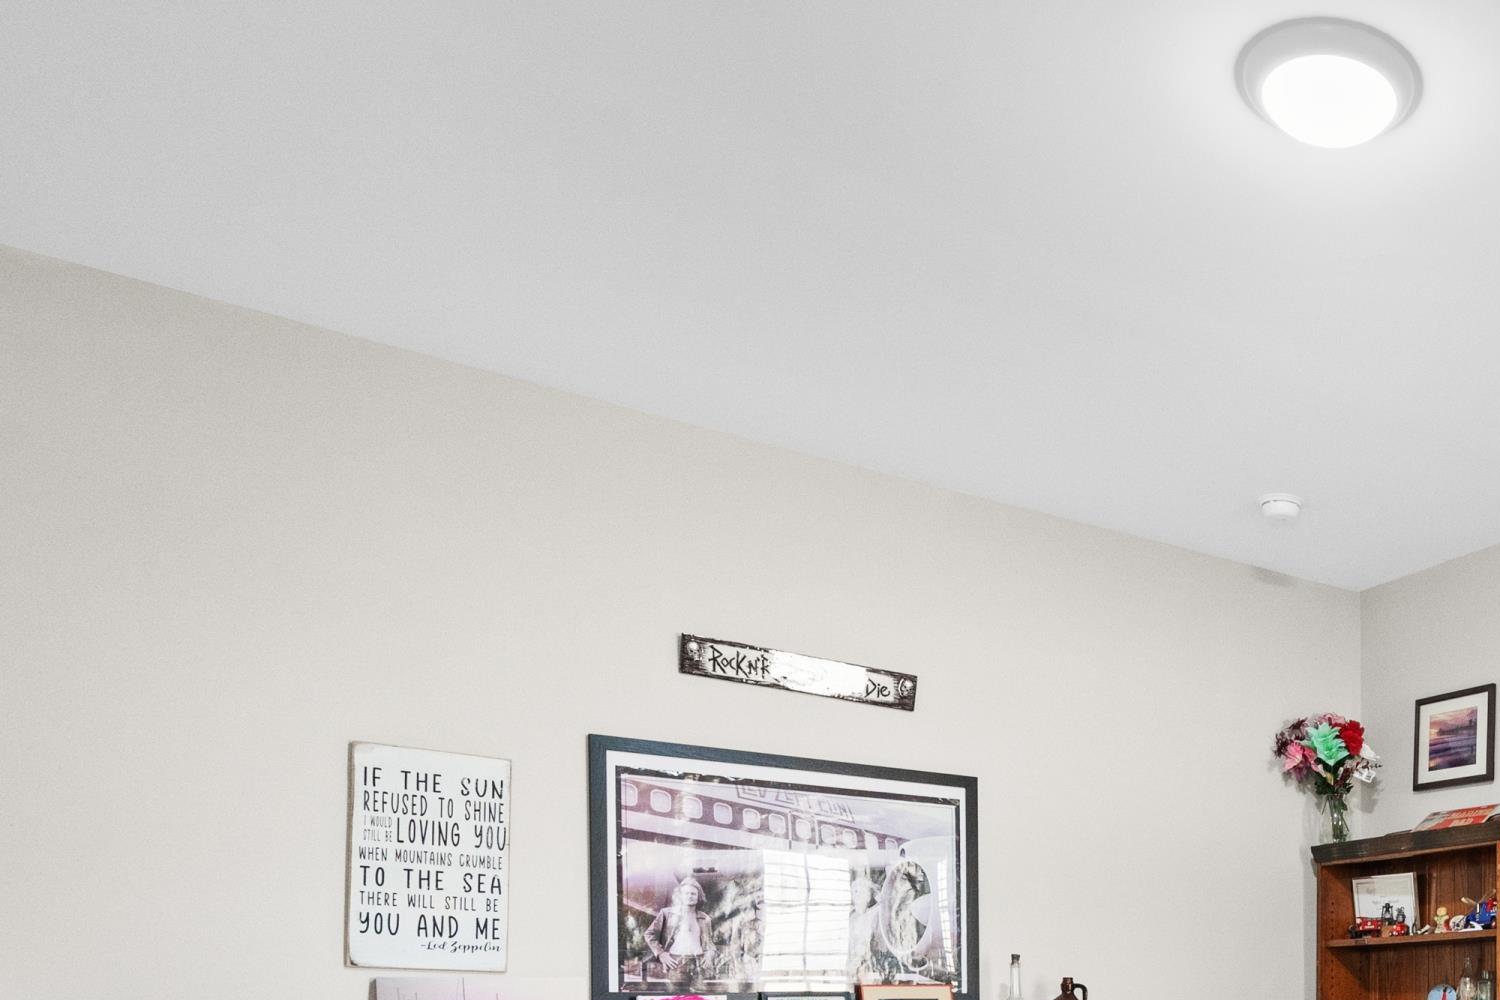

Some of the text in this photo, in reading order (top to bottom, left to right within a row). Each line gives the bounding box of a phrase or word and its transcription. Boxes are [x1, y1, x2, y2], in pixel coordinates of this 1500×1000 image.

[865, 678, 891, 699] Die
[363, 766, 504, 799] IF THE SUN
[363, 790, 505, 824] REFUSED TO SHINE
[370, 816, 393, 828] WOULD
[396, 817, 507, 851] LOVING YOU
[363, 829, 393, 842] STILL BE
[358, 846, 503, 870] WHEN MOUNTAINS CRUMBLE
[360, 865, 502, 895] TO THE SEA
[360, 891, 499, 912] THERE WILL STILL BE
[359, 911, 501, 940] YOU AND ME
[449, 941, 501, 953] Zeppelin
